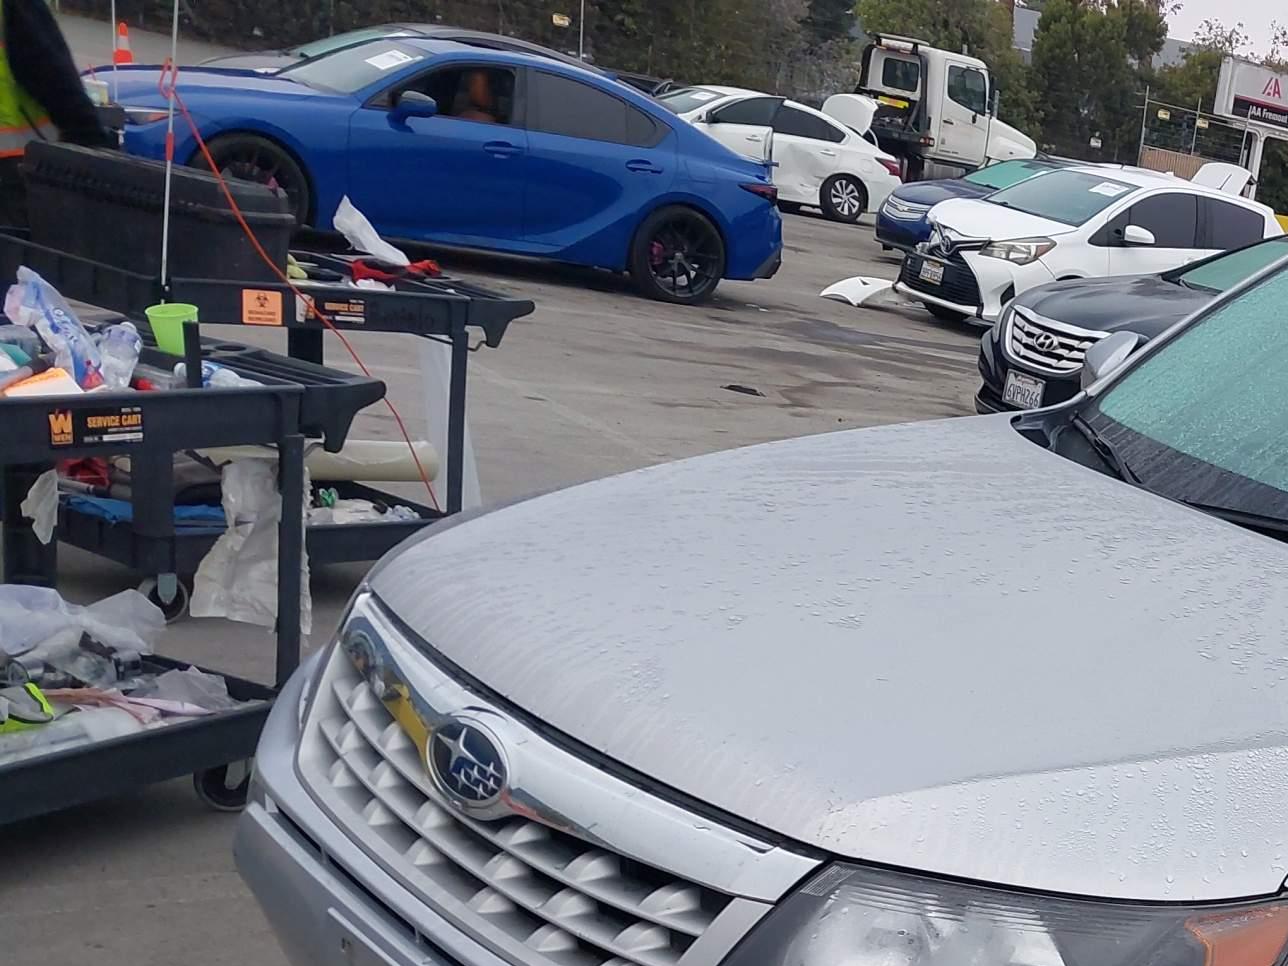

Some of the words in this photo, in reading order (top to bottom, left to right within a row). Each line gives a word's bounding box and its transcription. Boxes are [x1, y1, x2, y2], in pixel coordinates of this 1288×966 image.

[1262, 108, 1288, 124] Fremont
[1006, 383, 1040, 408] 6VPH266
[87, 415, 120, 428] SERVICE
[121, 414, 142, 426] CART
